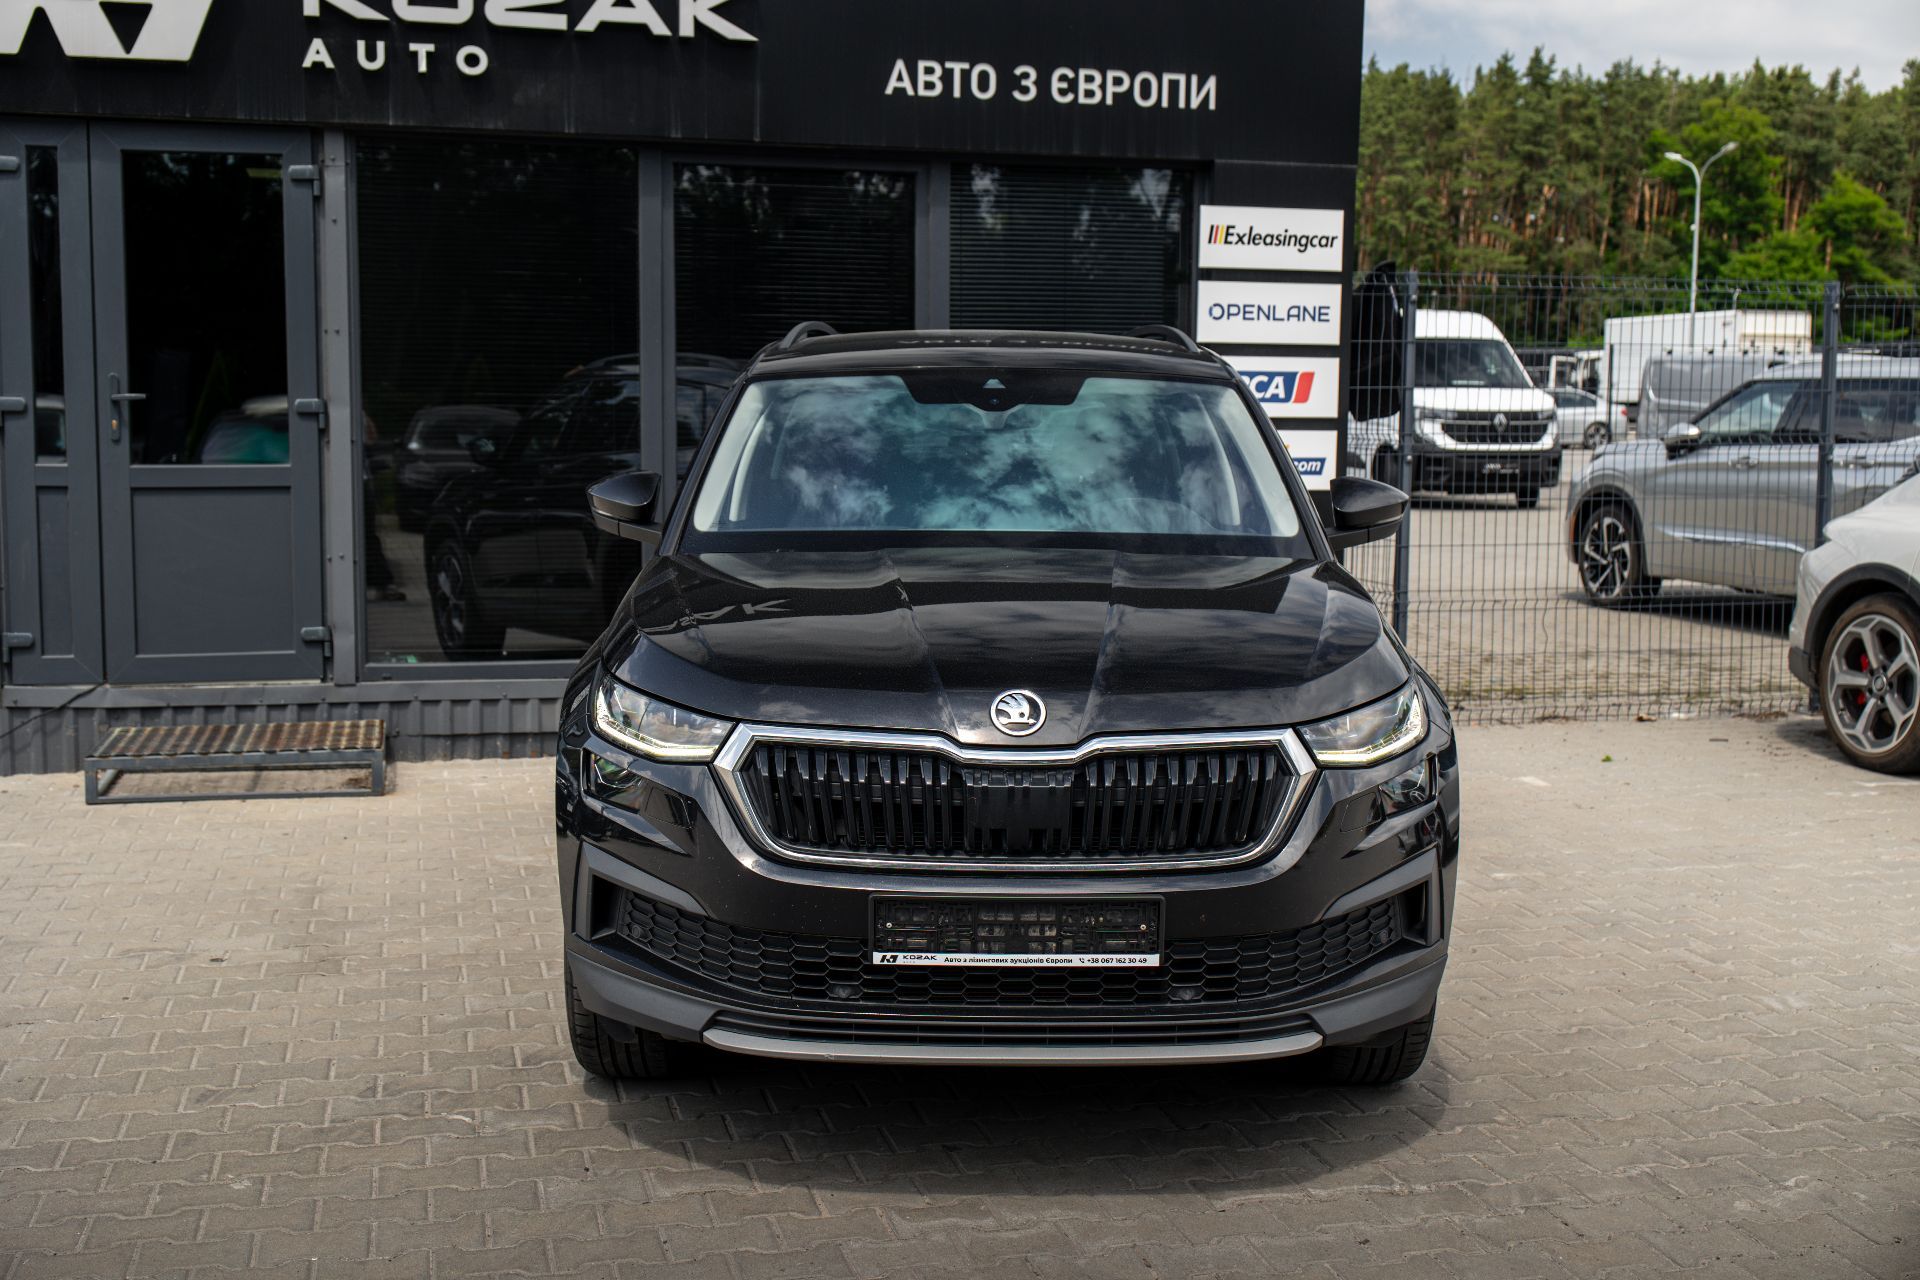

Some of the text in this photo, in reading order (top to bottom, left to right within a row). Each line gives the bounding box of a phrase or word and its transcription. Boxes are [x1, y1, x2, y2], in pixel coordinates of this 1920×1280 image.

[302, 37, 488, 76] AUTO
[884, 58, 1217, 111] АВТО З ЄВРОПИ
[1224, 225, 1338, 253] Exleasingcar
[1208, 302, 1331, 323] OPENLANE
[1010, 957, 1044, 965] аукціонів
[1045, 957, 1073, 965] Європи
